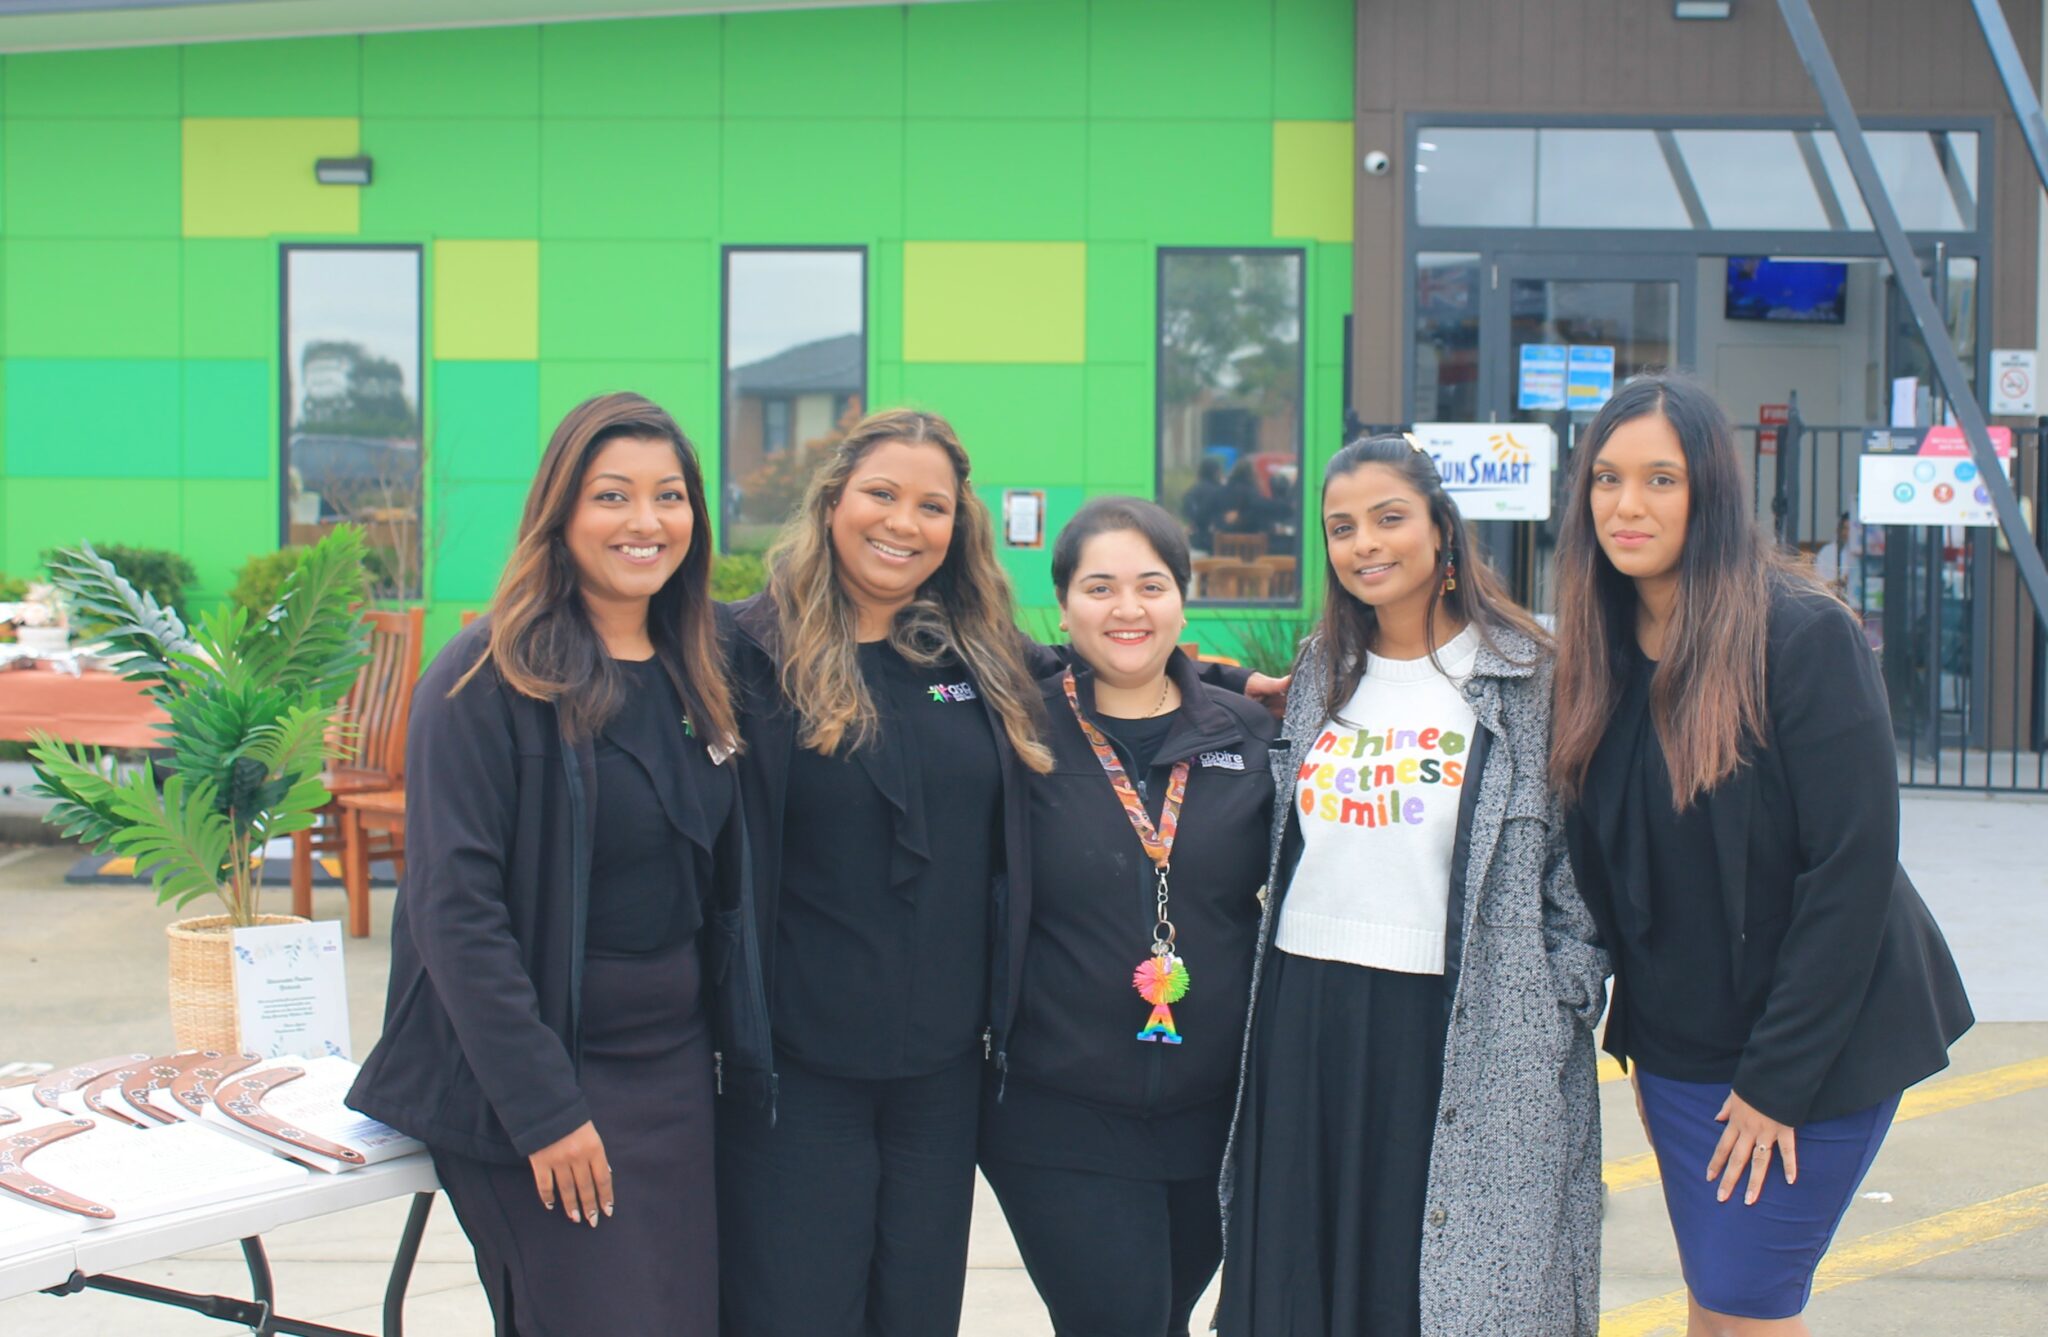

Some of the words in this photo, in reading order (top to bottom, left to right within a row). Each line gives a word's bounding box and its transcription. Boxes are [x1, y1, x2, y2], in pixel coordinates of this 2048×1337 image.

[1200, 750, 1243, 764] aspire
[1315, 727, 1440, 758] nshine
[1319, 790, 1425, 828] smile
[1137, 1003, 1183, 1045] A
